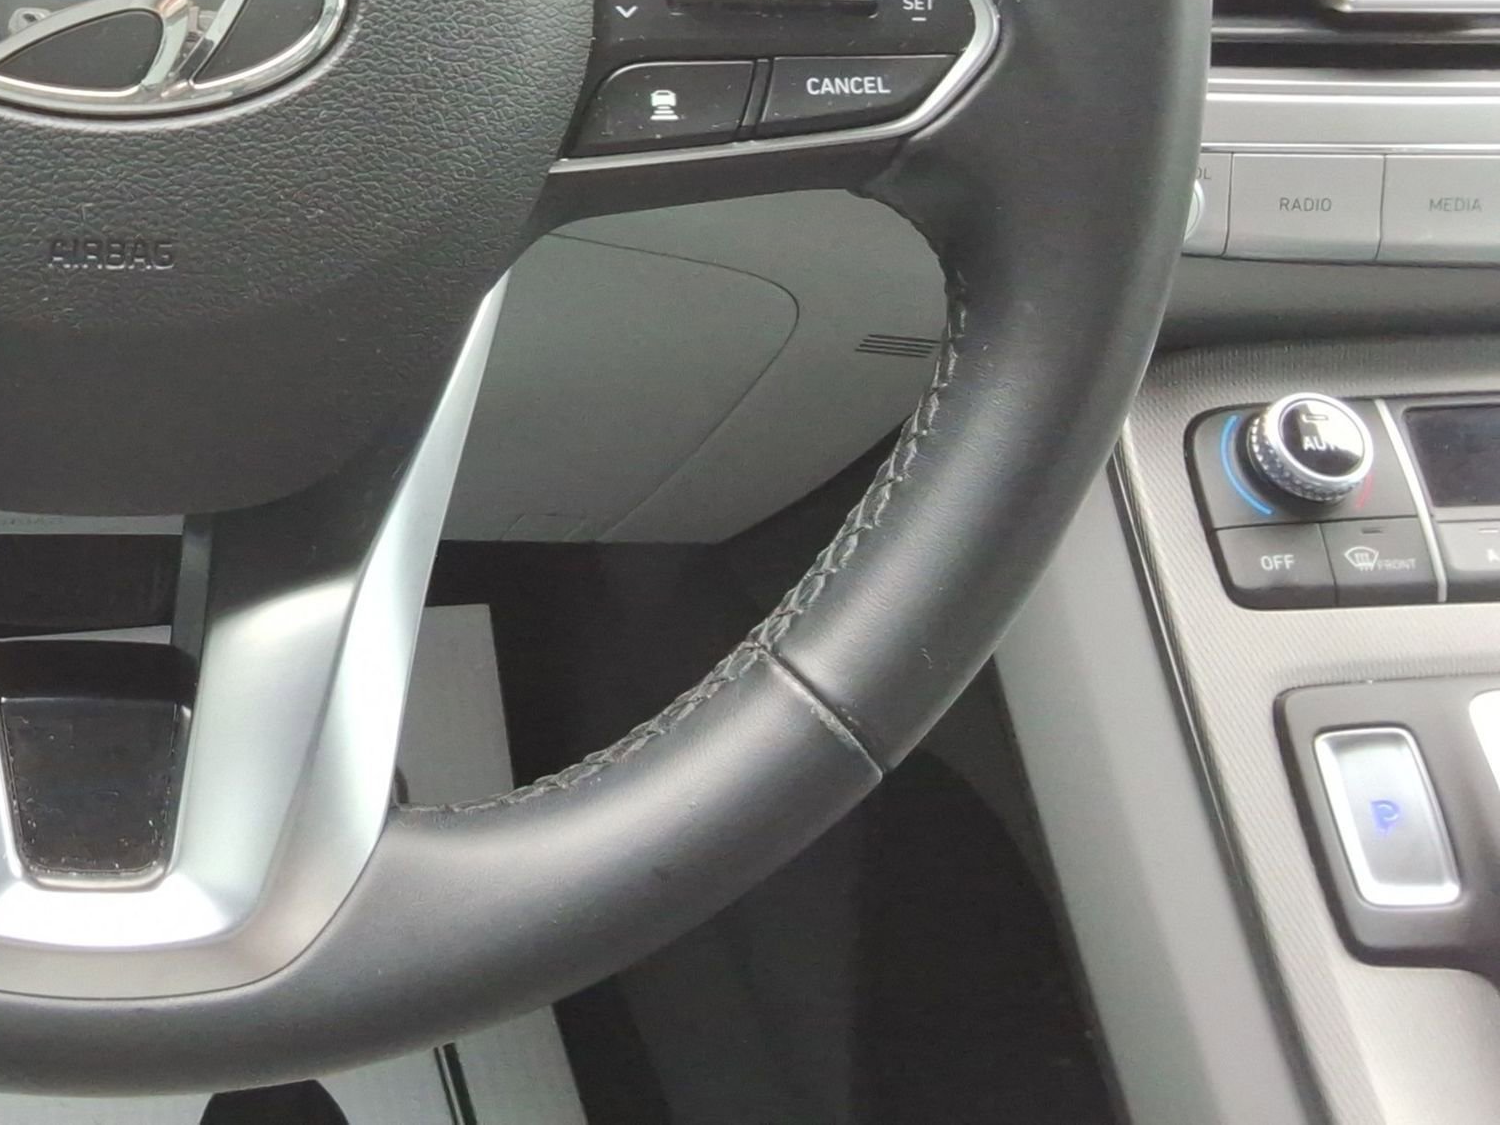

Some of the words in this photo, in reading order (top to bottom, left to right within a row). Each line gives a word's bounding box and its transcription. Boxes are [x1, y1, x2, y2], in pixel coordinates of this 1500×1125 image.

[806, 77, 891, 96] CANCEL
[1279, 197, 1333, 212] RADIO
[1429, 198, 1483, 213] MEDIA
[49, 240, 175, 270] AIRBAG
[1260, 554, 1295, 571] OFF
[1378, 558, 1416, 571] FRONT
